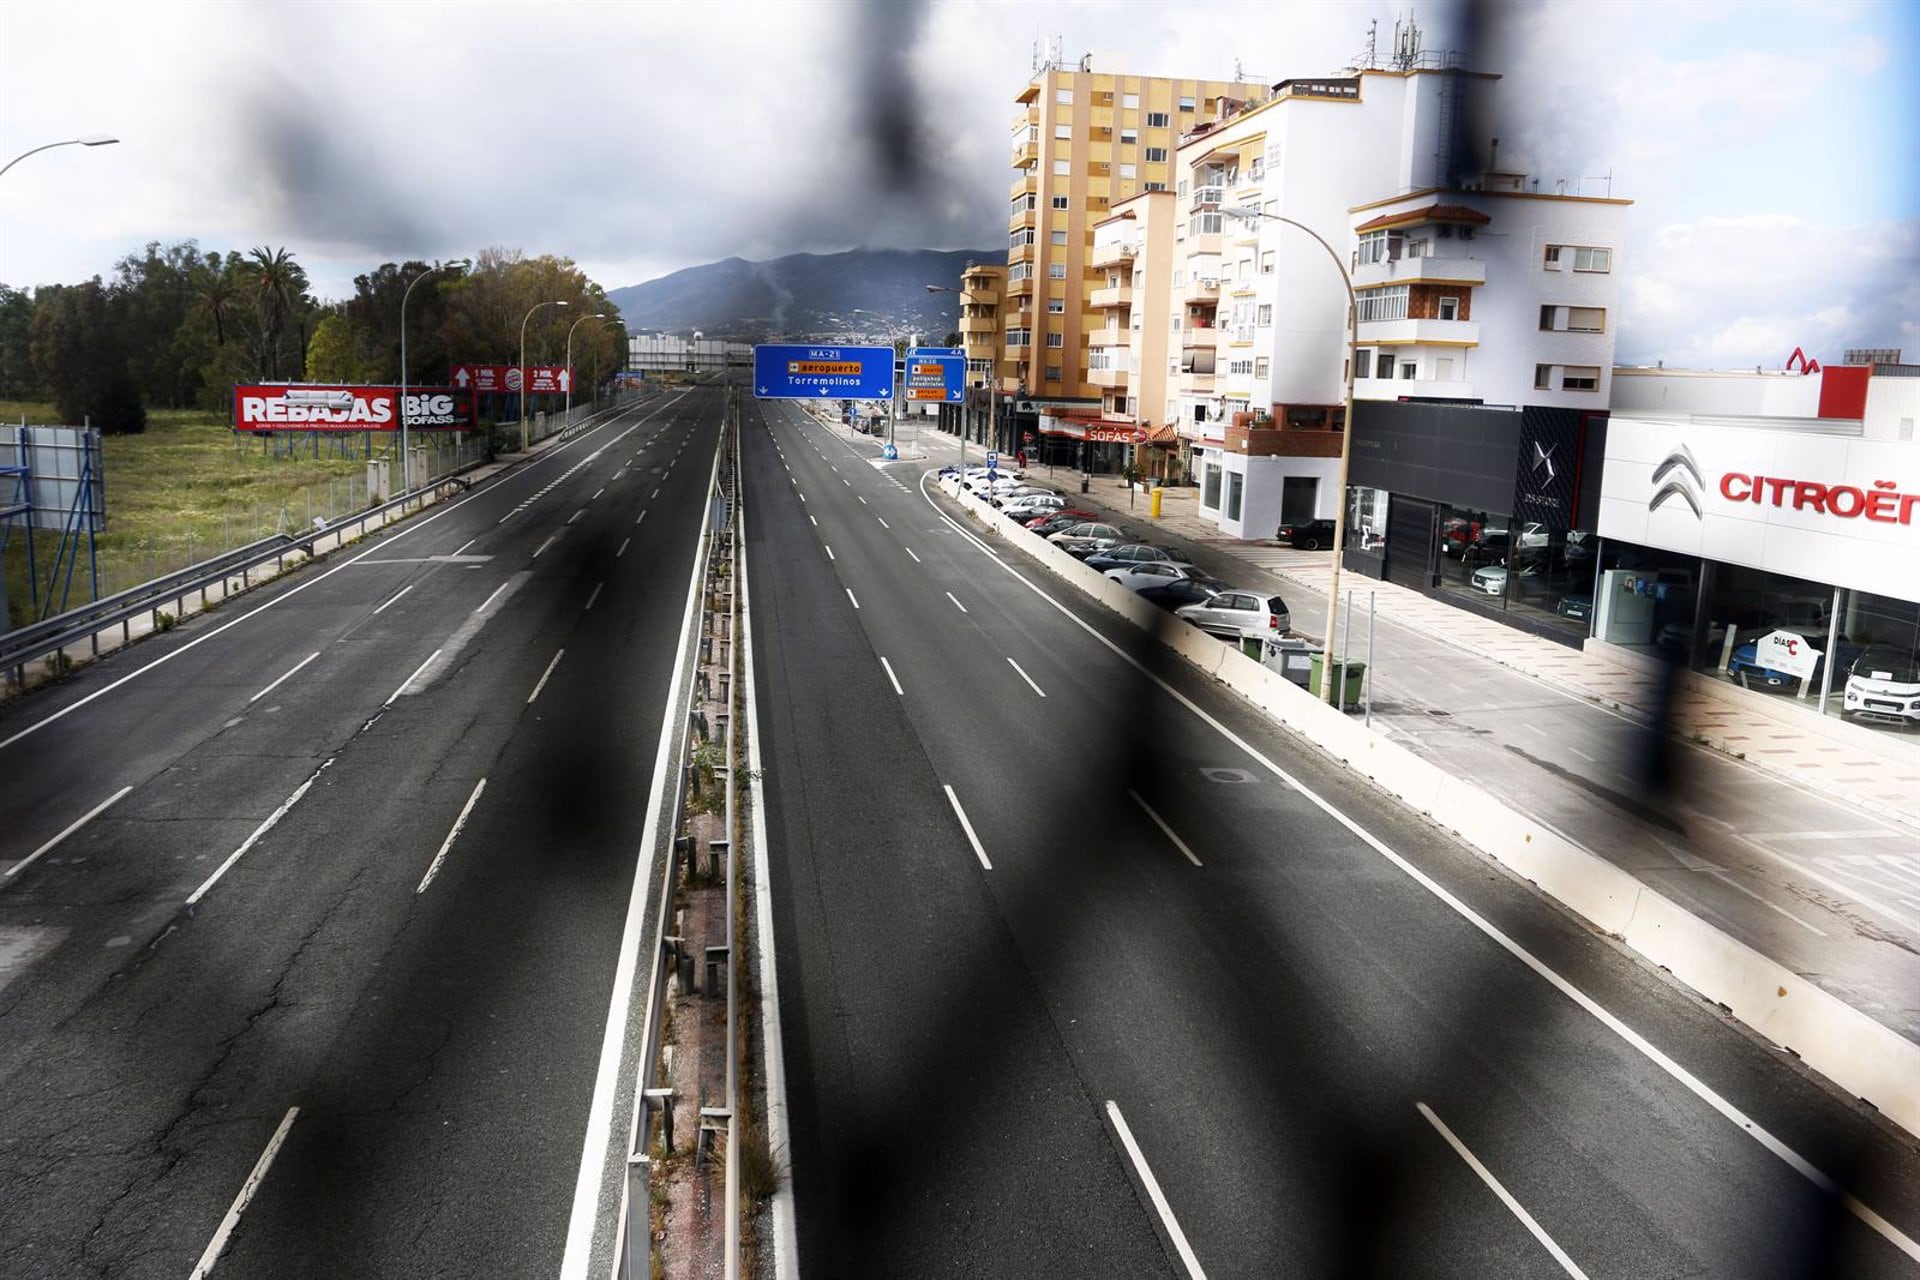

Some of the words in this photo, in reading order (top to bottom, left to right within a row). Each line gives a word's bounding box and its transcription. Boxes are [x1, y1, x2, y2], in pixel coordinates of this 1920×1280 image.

[810, 350, 839, 358] MA-21
[802, 364, 860, 373] aeropuerto
[788, 376, 861, 386] Torremolinos
[243, 396, 392, 423] REBAJAS
